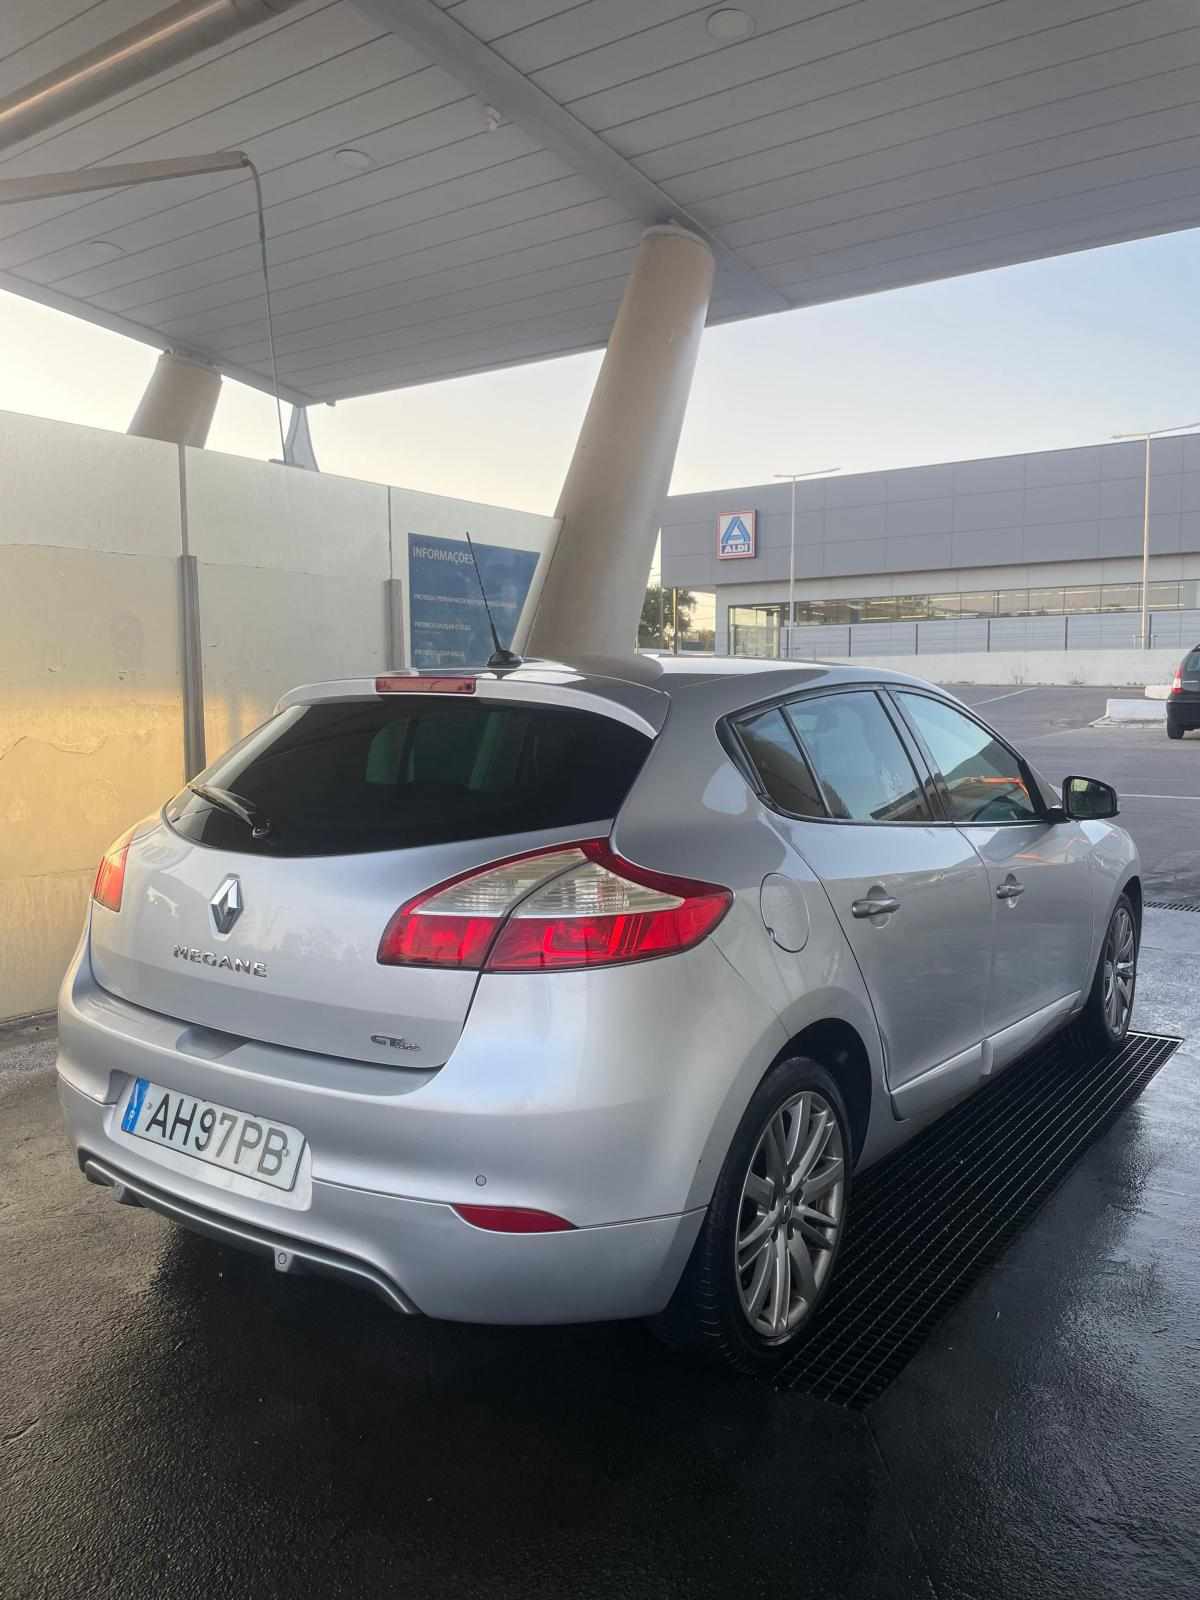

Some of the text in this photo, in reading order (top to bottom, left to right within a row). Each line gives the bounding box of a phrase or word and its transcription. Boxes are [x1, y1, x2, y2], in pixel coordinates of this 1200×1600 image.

[721, 544, 750, 554] ALDI
[173, 944, 268, 978] MEGANE
[145, 1092, 289, 1177] AH97PB
